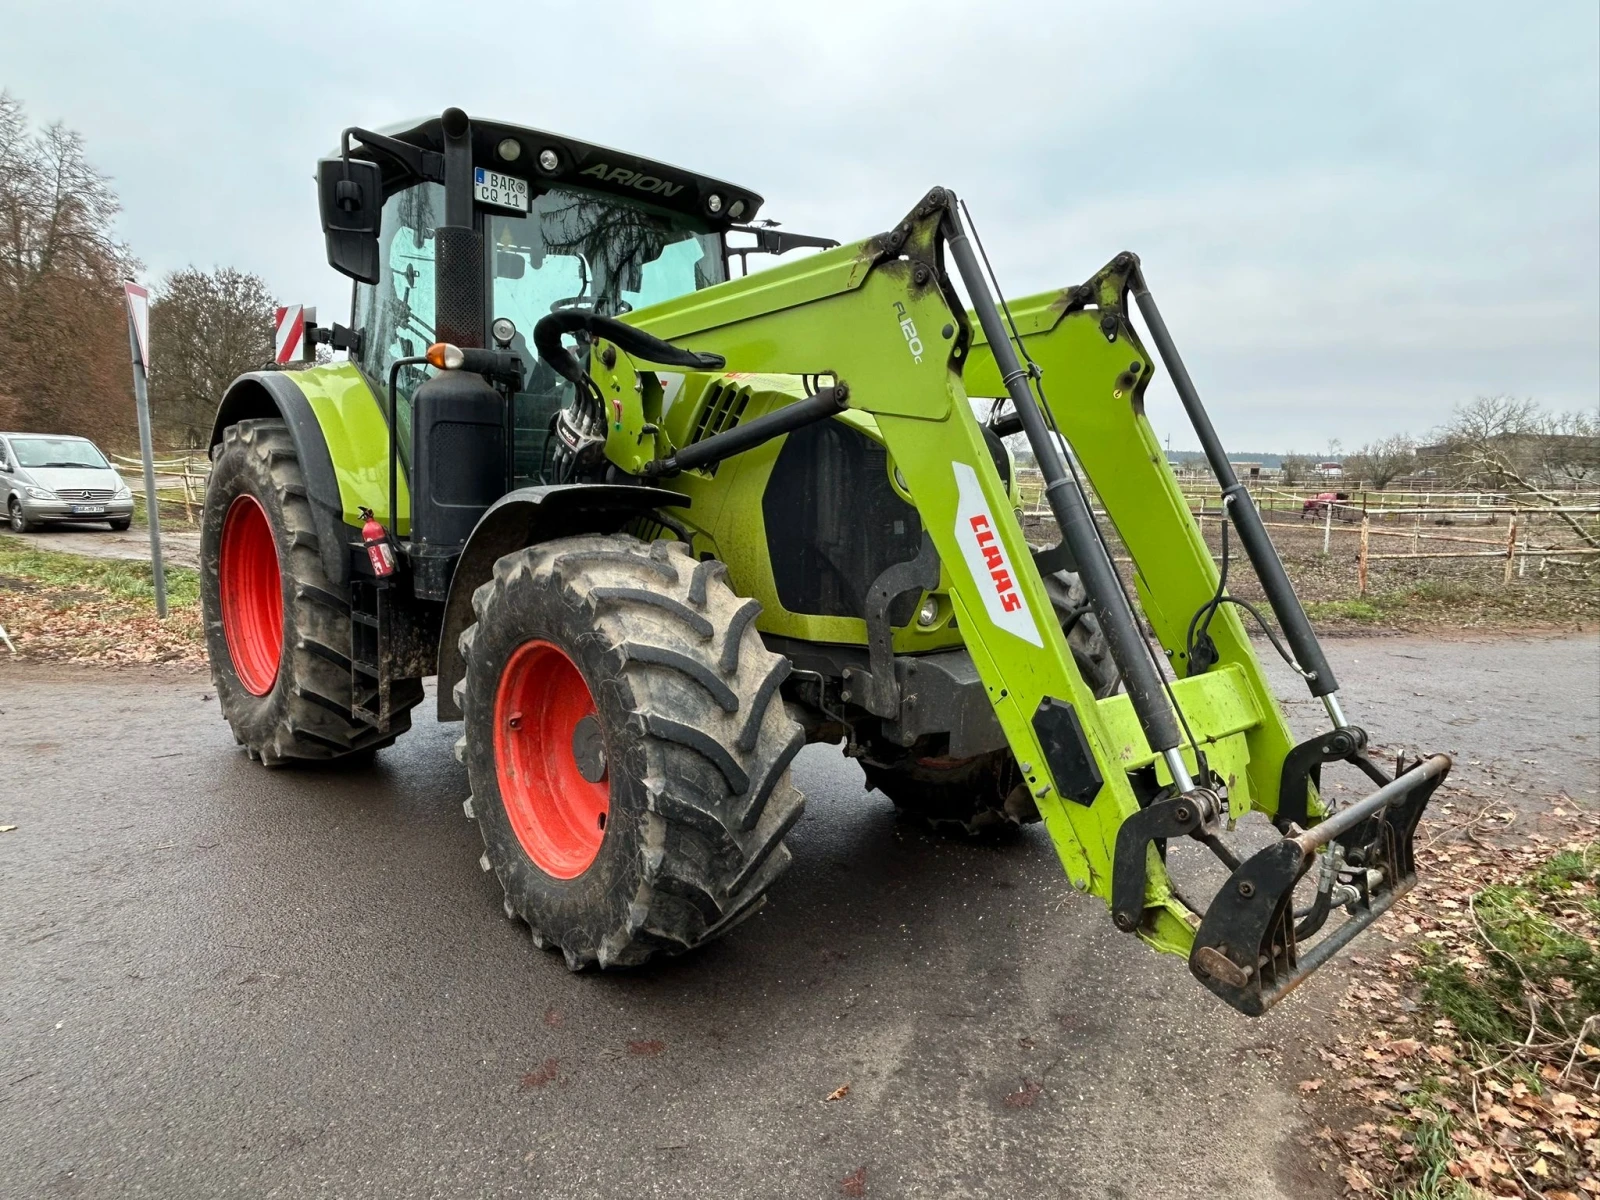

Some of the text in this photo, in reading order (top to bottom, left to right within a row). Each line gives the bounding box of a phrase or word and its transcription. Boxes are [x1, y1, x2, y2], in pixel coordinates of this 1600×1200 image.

[491, 173, 516, 192] BAR
[580, 163, 684, 197] ARION
[481, 186, 520, 207] CQ 11
[969, 514, 1022, 613] CLAAS
